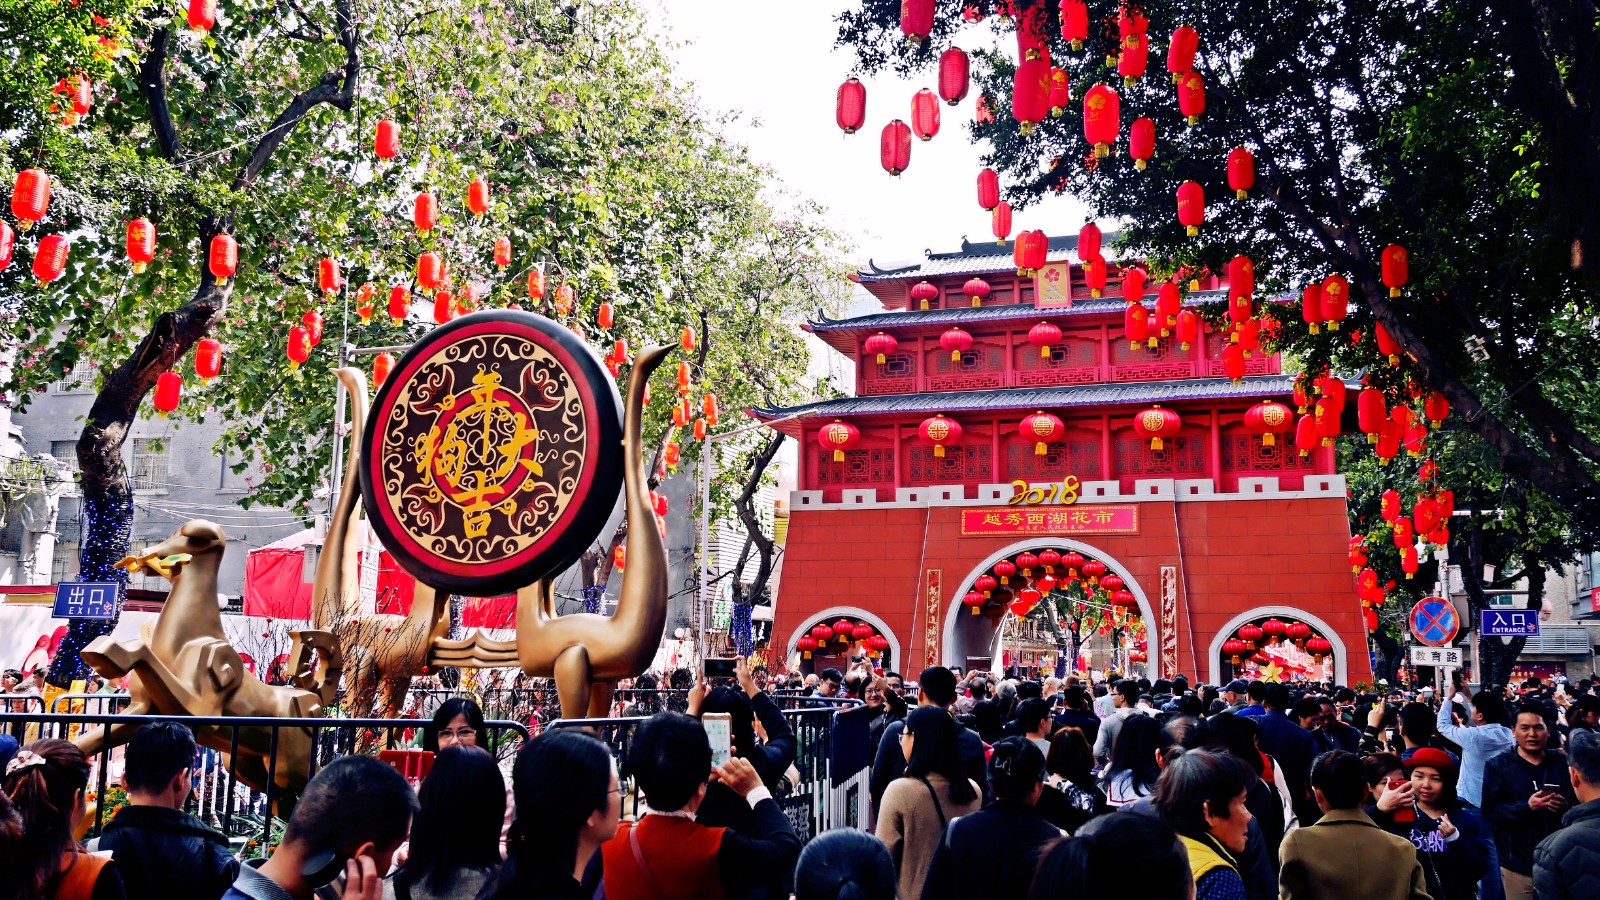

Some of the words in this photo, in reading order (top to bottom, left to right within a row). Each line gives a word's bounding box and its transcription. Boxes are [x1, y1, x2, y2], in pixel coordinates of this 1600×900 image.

[1008, 475, 1079, 505] 2018
[981, 511, 1115, 526] 越秀西湖花市
[68, 587, 104, 606] 出口
[68, 606, 100, 615] EXIT
[1492, 612, 1526, 626] 入口
[1415, 650, 1458, 663] 教育路
